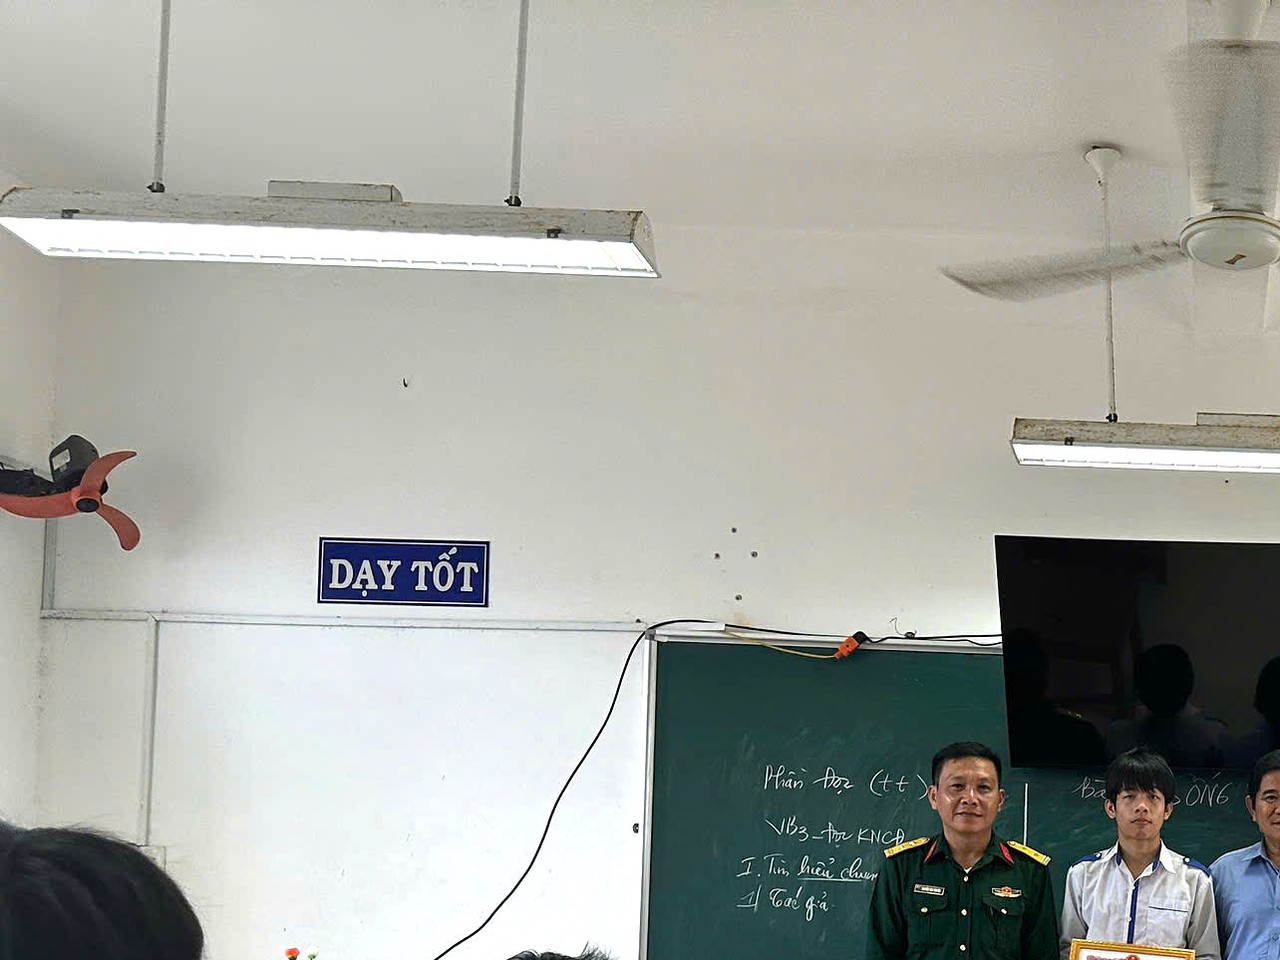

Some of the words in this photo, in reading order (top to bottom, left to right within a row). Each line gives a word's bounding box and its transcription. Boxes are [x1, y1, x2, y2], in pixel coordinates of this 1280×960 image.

[329, 558, 401, 597] DẠY
[410, 546, 479, 592] TỐT
[763, 764, 807, 790] Phần
